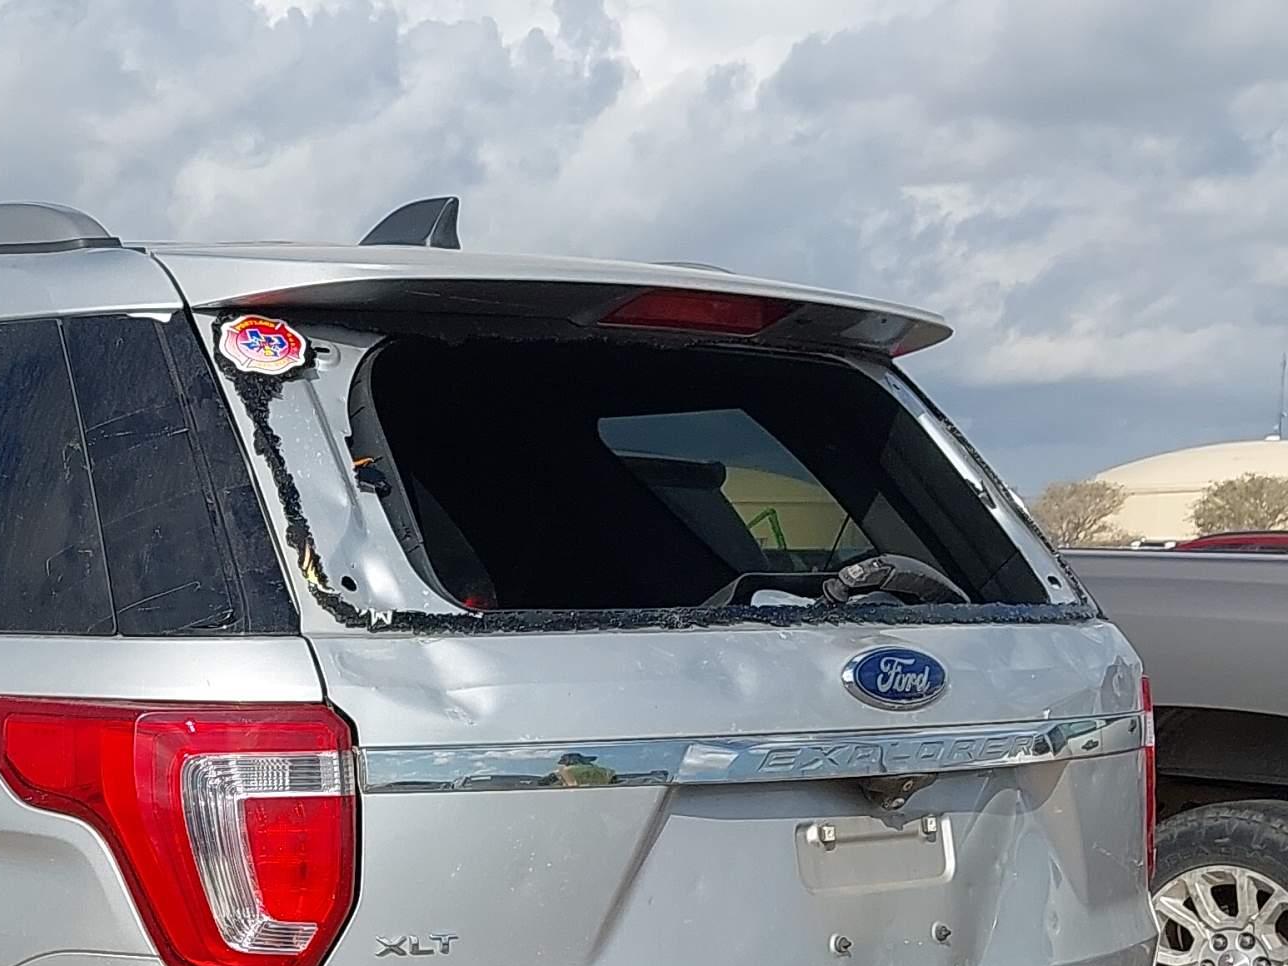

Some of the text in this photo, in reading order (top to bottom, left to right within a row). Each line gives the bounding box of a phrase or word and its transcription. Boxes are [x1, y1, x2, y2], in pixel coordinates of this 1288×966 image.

[876, 656, 931, 693] Ford
[758, 733, 1040, 773] EXPLORER
[375, 934, 459, 957] XLT
